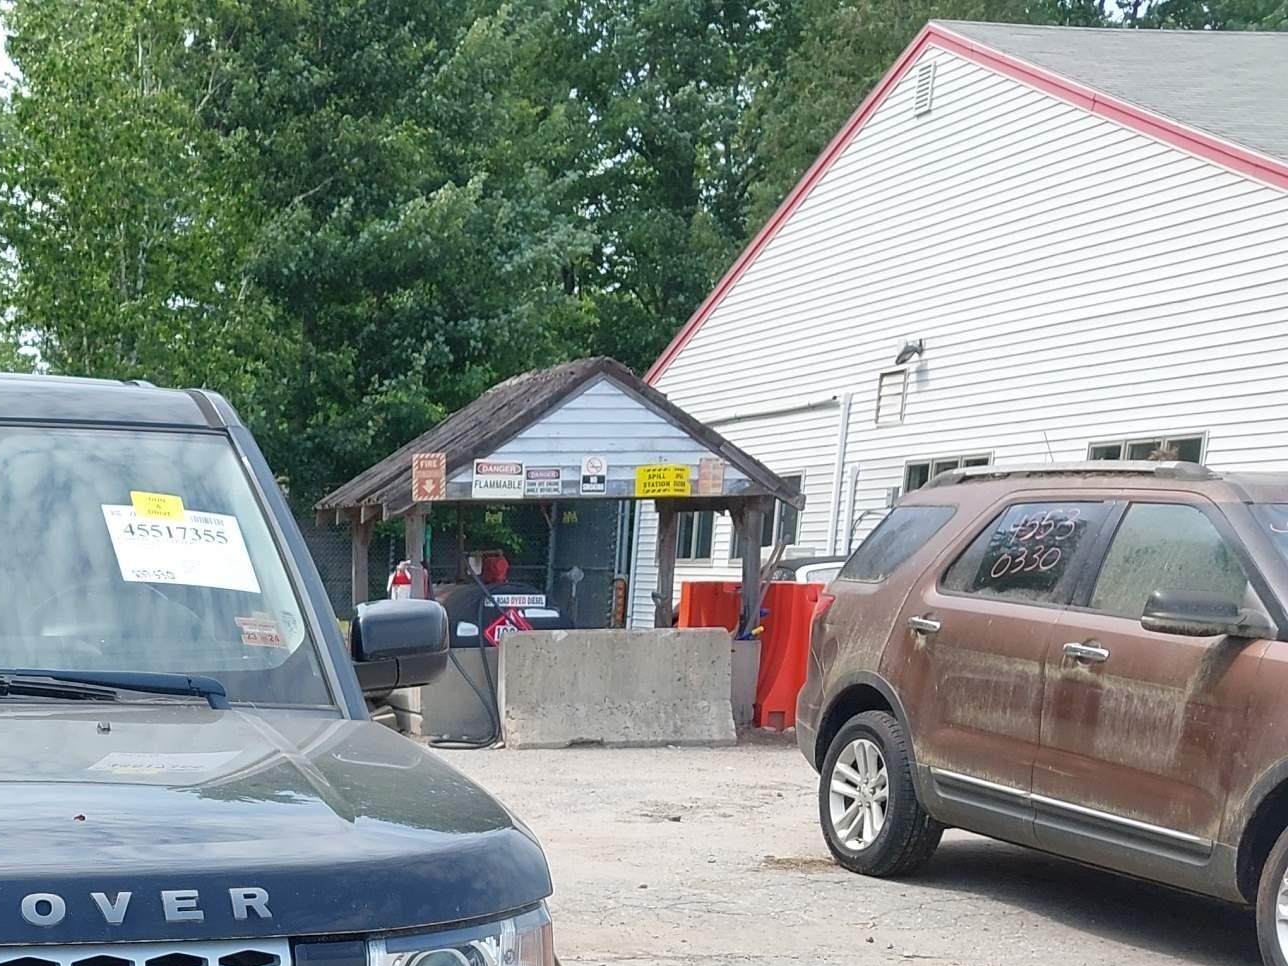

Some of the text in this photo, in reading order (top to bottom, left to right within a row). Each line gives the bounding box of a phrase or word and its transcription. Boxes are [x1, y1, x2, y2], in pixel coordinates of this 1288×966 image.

[419, 459, 438, 468] FIRE
[482, 463, 516, 474] DANGER
[474, 479, 522, 489] FLAMMABLE
[123, 521, 229, 545] 45517355
[1010, 507, 1081, 545] 4553
[990, 544, 1062, 578] 0330
